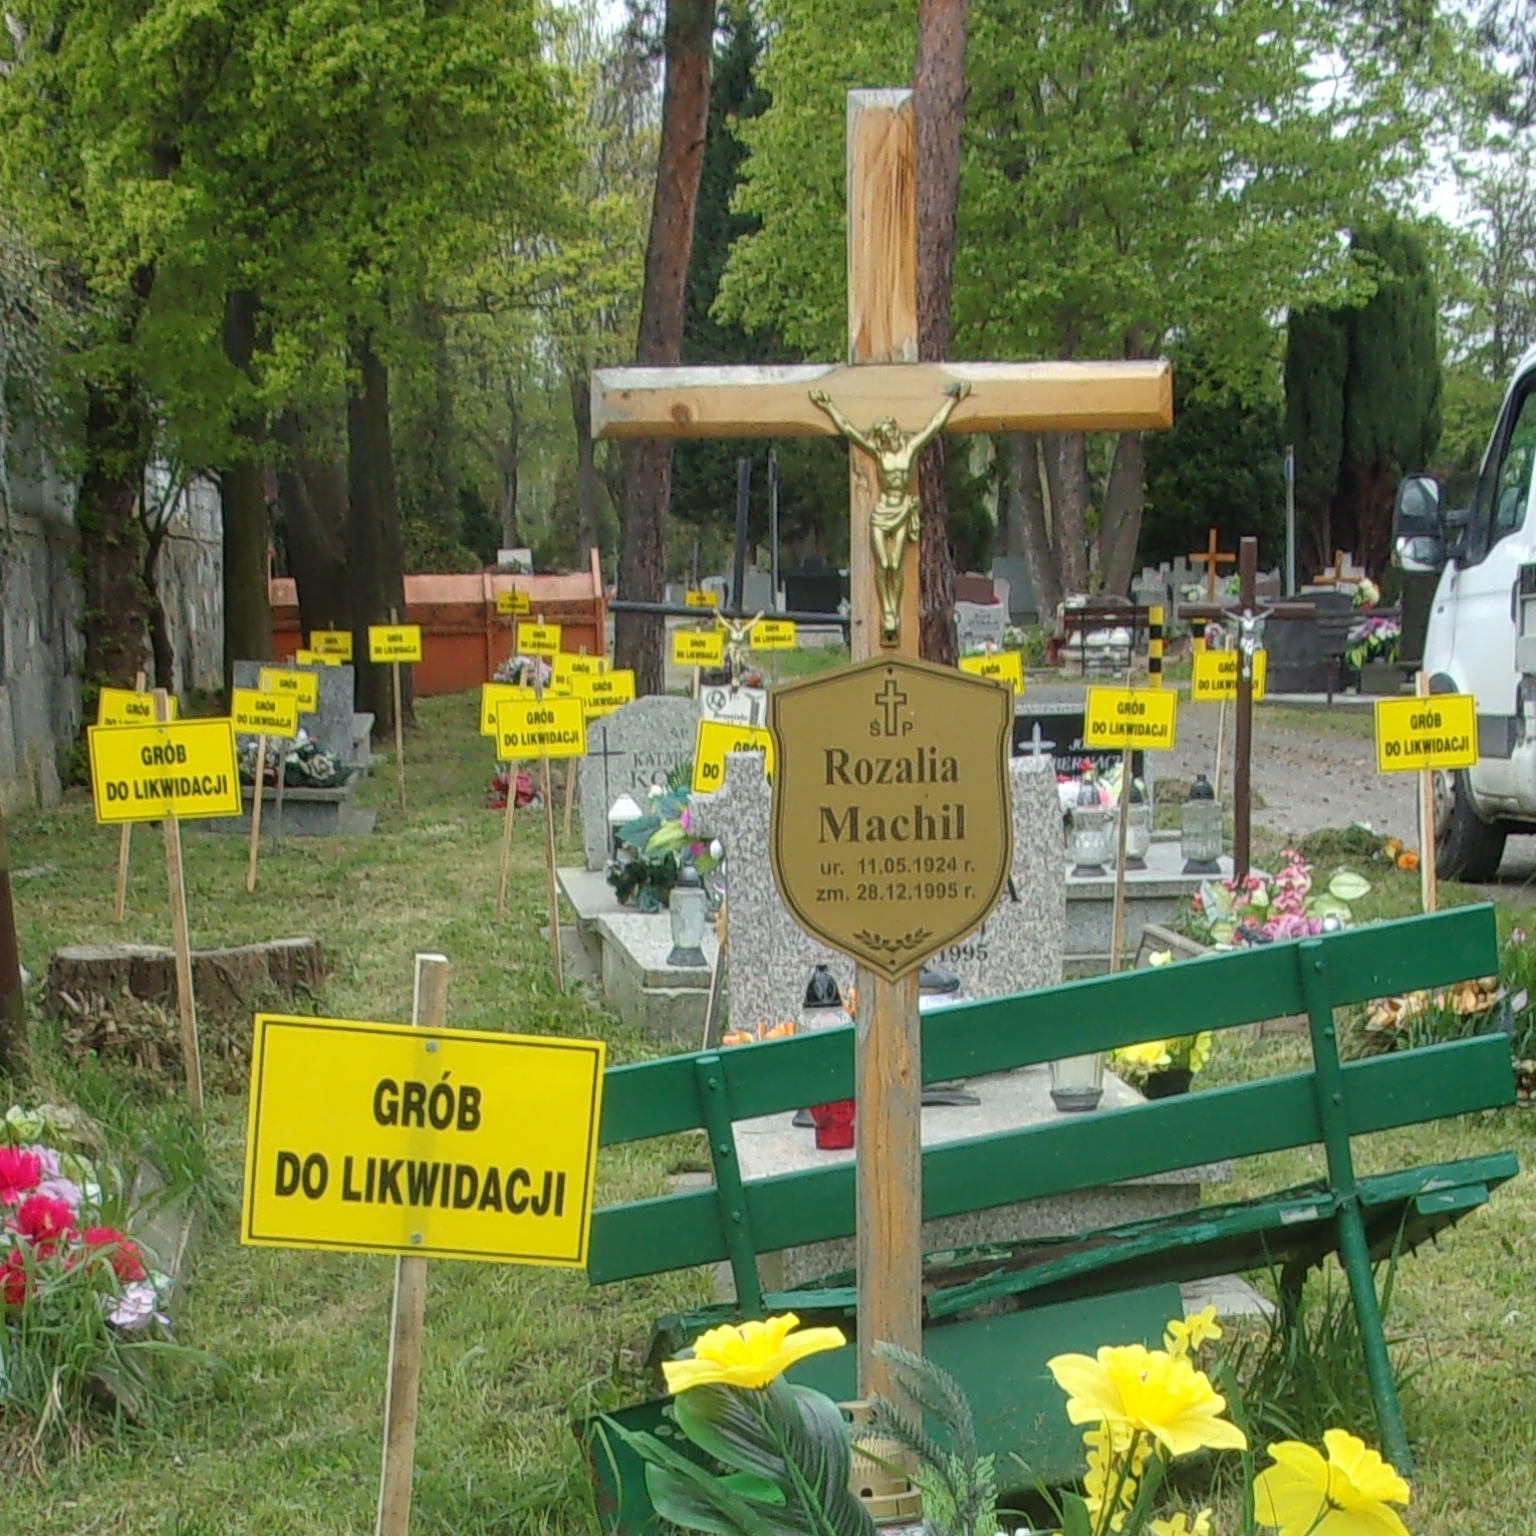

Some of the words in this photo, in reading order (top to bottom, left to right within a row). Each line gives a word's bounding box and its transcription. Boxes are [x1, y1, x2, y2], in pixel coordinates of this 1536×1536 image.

[1218, 660, 1236, 674] GRÓ
[527, 708, 555, 725] GRÓB
[1117, 699, 1145, 715] GRÓB
[902, 721, 913, 737] P
[1092, 722, 1106, 735] DO
[1109, 723, 1168, 737] LIKWIDACJI
[1410, 709, 1442, 730] GRÓB
[504, 734, 518, 747] DO
[521, 731, 579, 746] LIKWIDACJI
[1385, 740, 1401, 757] DO
[1404, 736, 1469, 755] LIKWIDACJI
[141, 740, 187, 766] GRÓB
[702, 763, 719, 779] DO
[824, 746, 960, 785] Rozalia
[106, 781, 128, 801] DO
[134, 775, 227, 800] LIKWIDACJI
[818, 804, 965, 843] Machil
[820, 861, 844, 876] ur.
[858, 856, 957, 875] 11.05.1924
[964, 860, 975, 873] r.
[816, 888, 850, 901] zm.
[857, 882, 958, 901] 28.12.1995
[964, 886, 976, 899] r.
[373, 1071, 482, 1132] GRÓB
[274, 1150, 328, 1200] DO
[341, 1155, 566, 1217] LIKWIDACJI
